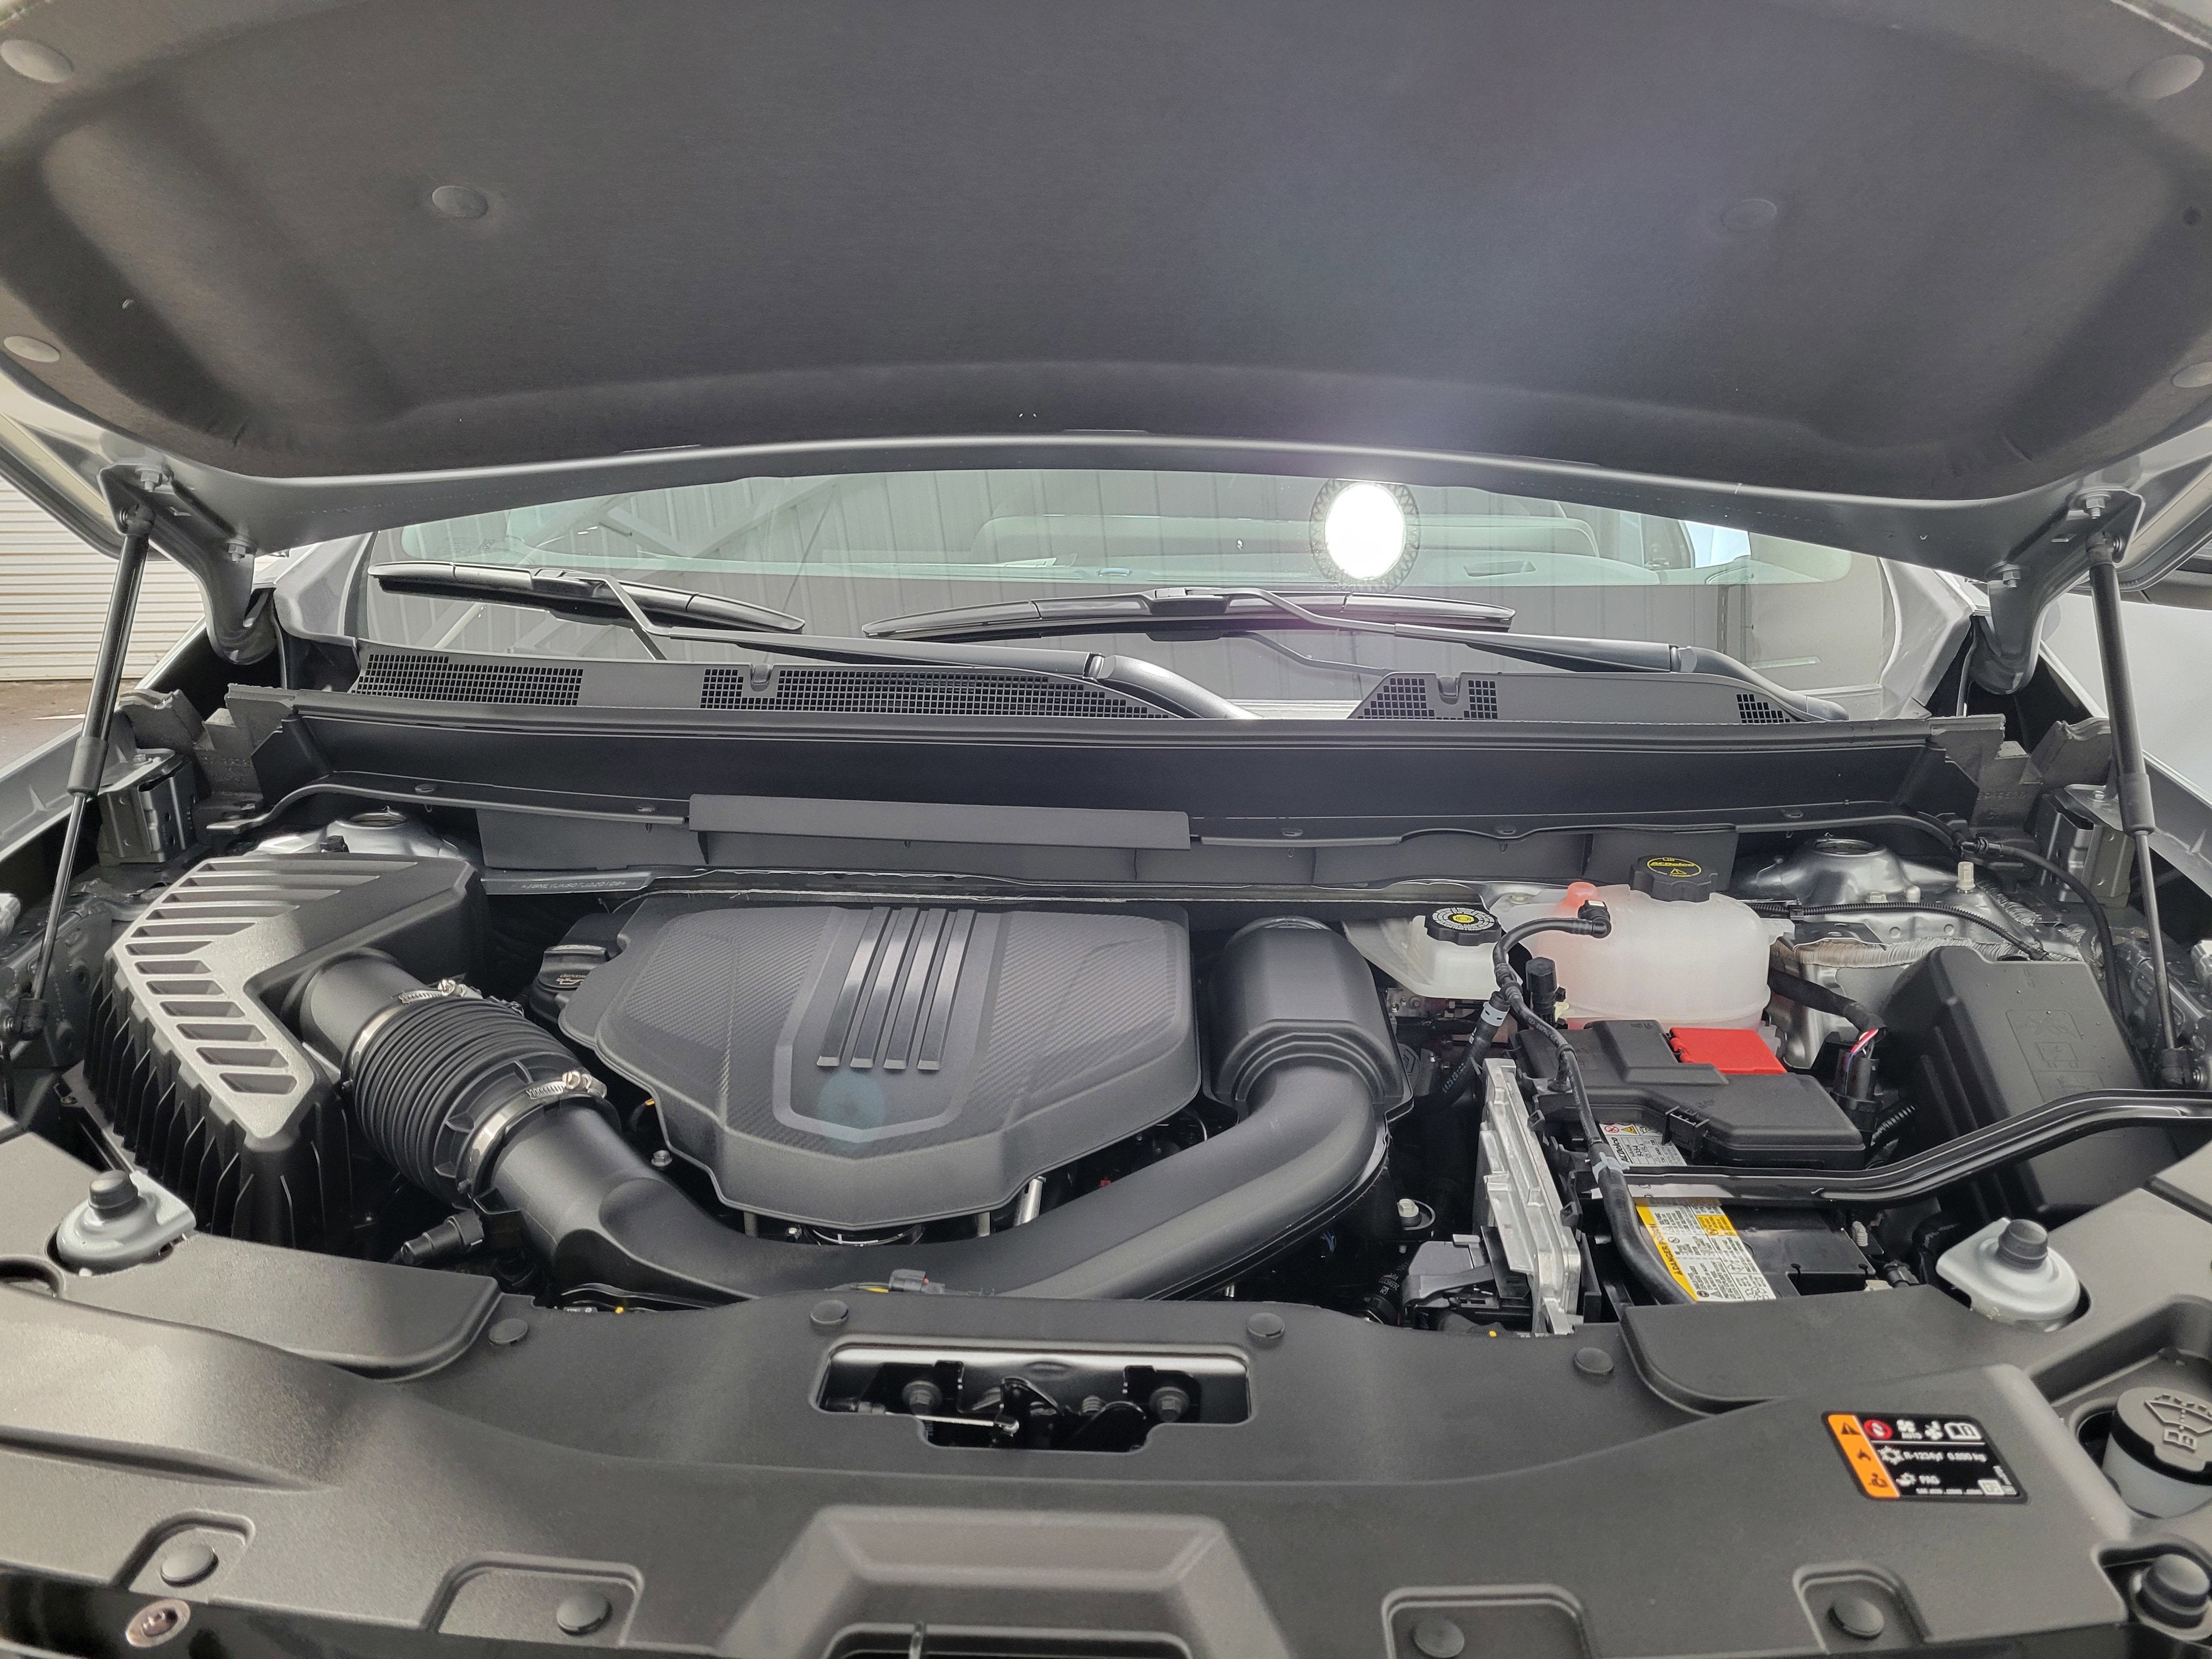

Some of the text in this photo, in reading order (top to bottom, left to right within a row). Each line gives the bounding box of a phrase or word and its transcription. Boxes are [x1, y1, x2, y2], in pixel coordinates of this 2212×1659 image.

[1611, 1137, 1630, 1163] ACDelco
[1633, 1145, 1644, 1157] 9354
[1662, 1246, 1680, 1273] DANGER
